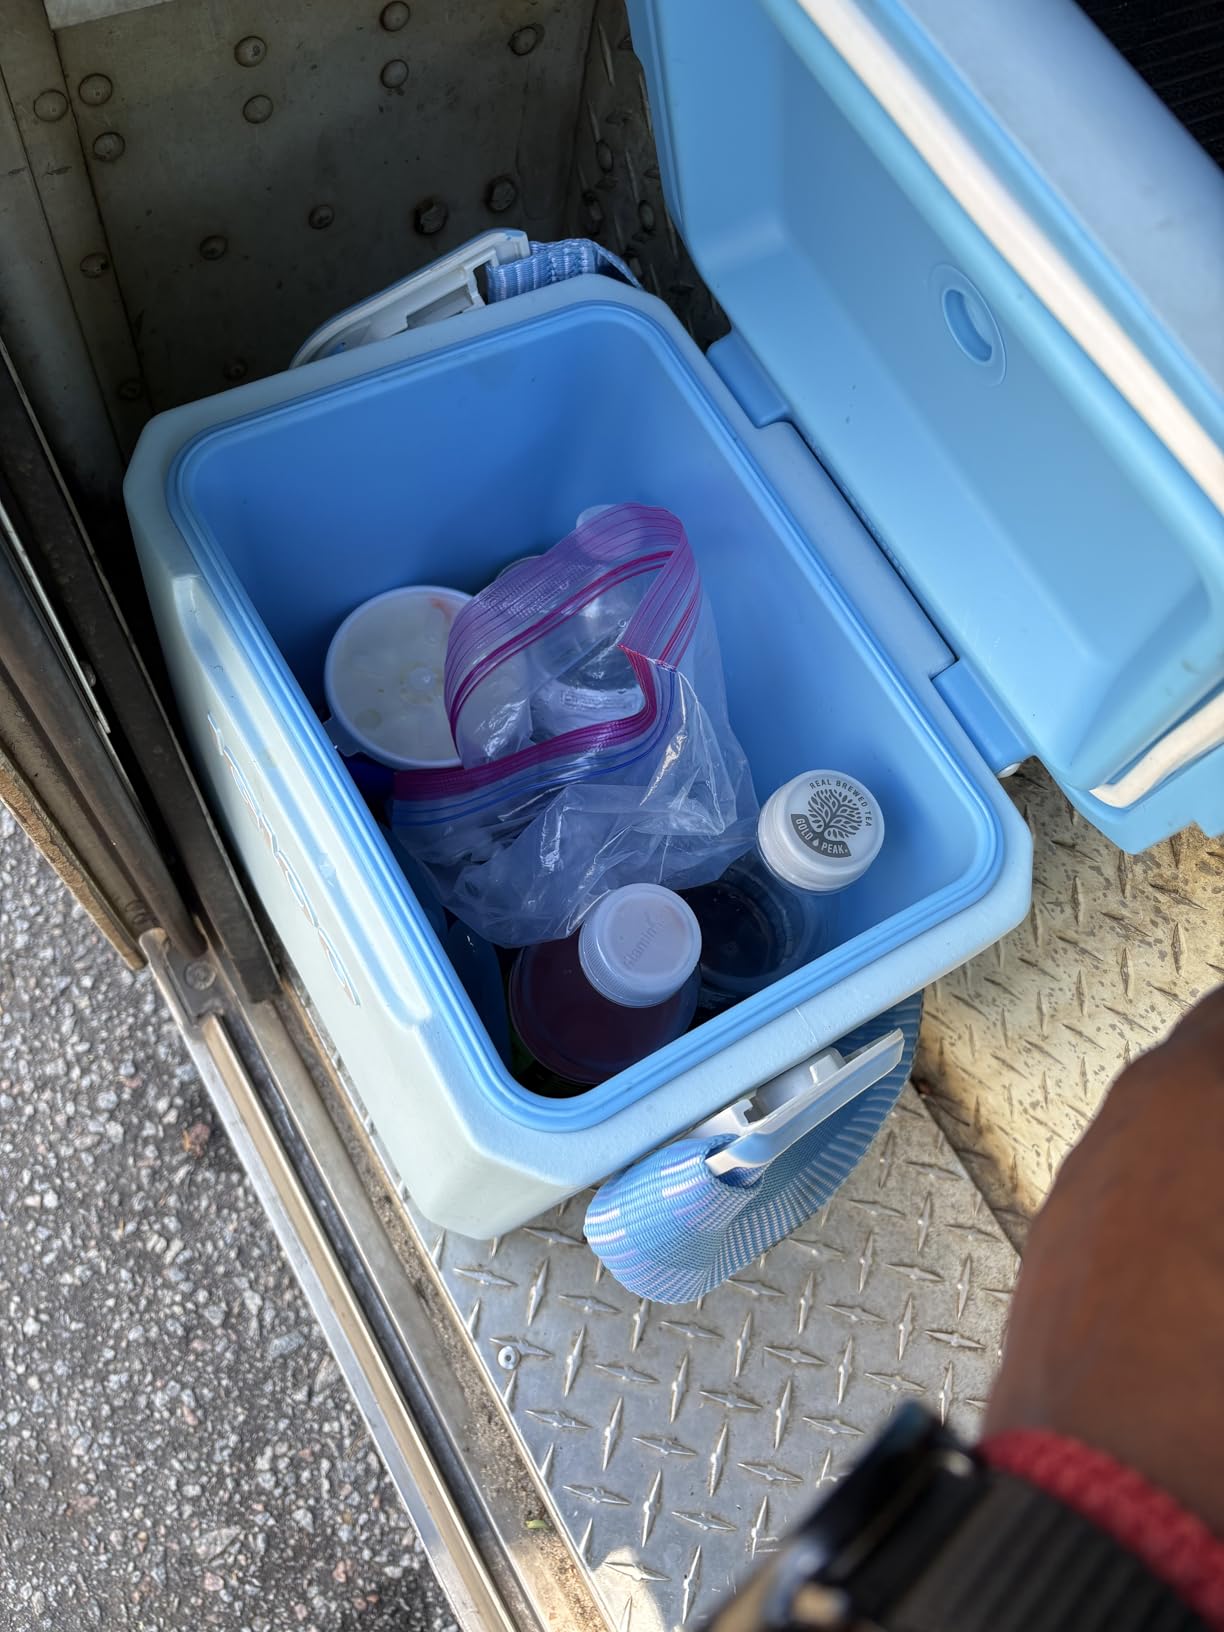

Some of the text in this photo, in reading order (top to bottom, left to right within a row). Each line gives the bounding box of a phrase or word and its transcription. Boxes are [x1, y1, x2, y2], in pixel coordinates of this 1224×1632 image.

[809, 779, 873, 827] REAL BREWED TEA
[795, 818, 845, 854] GOLD PEAK
